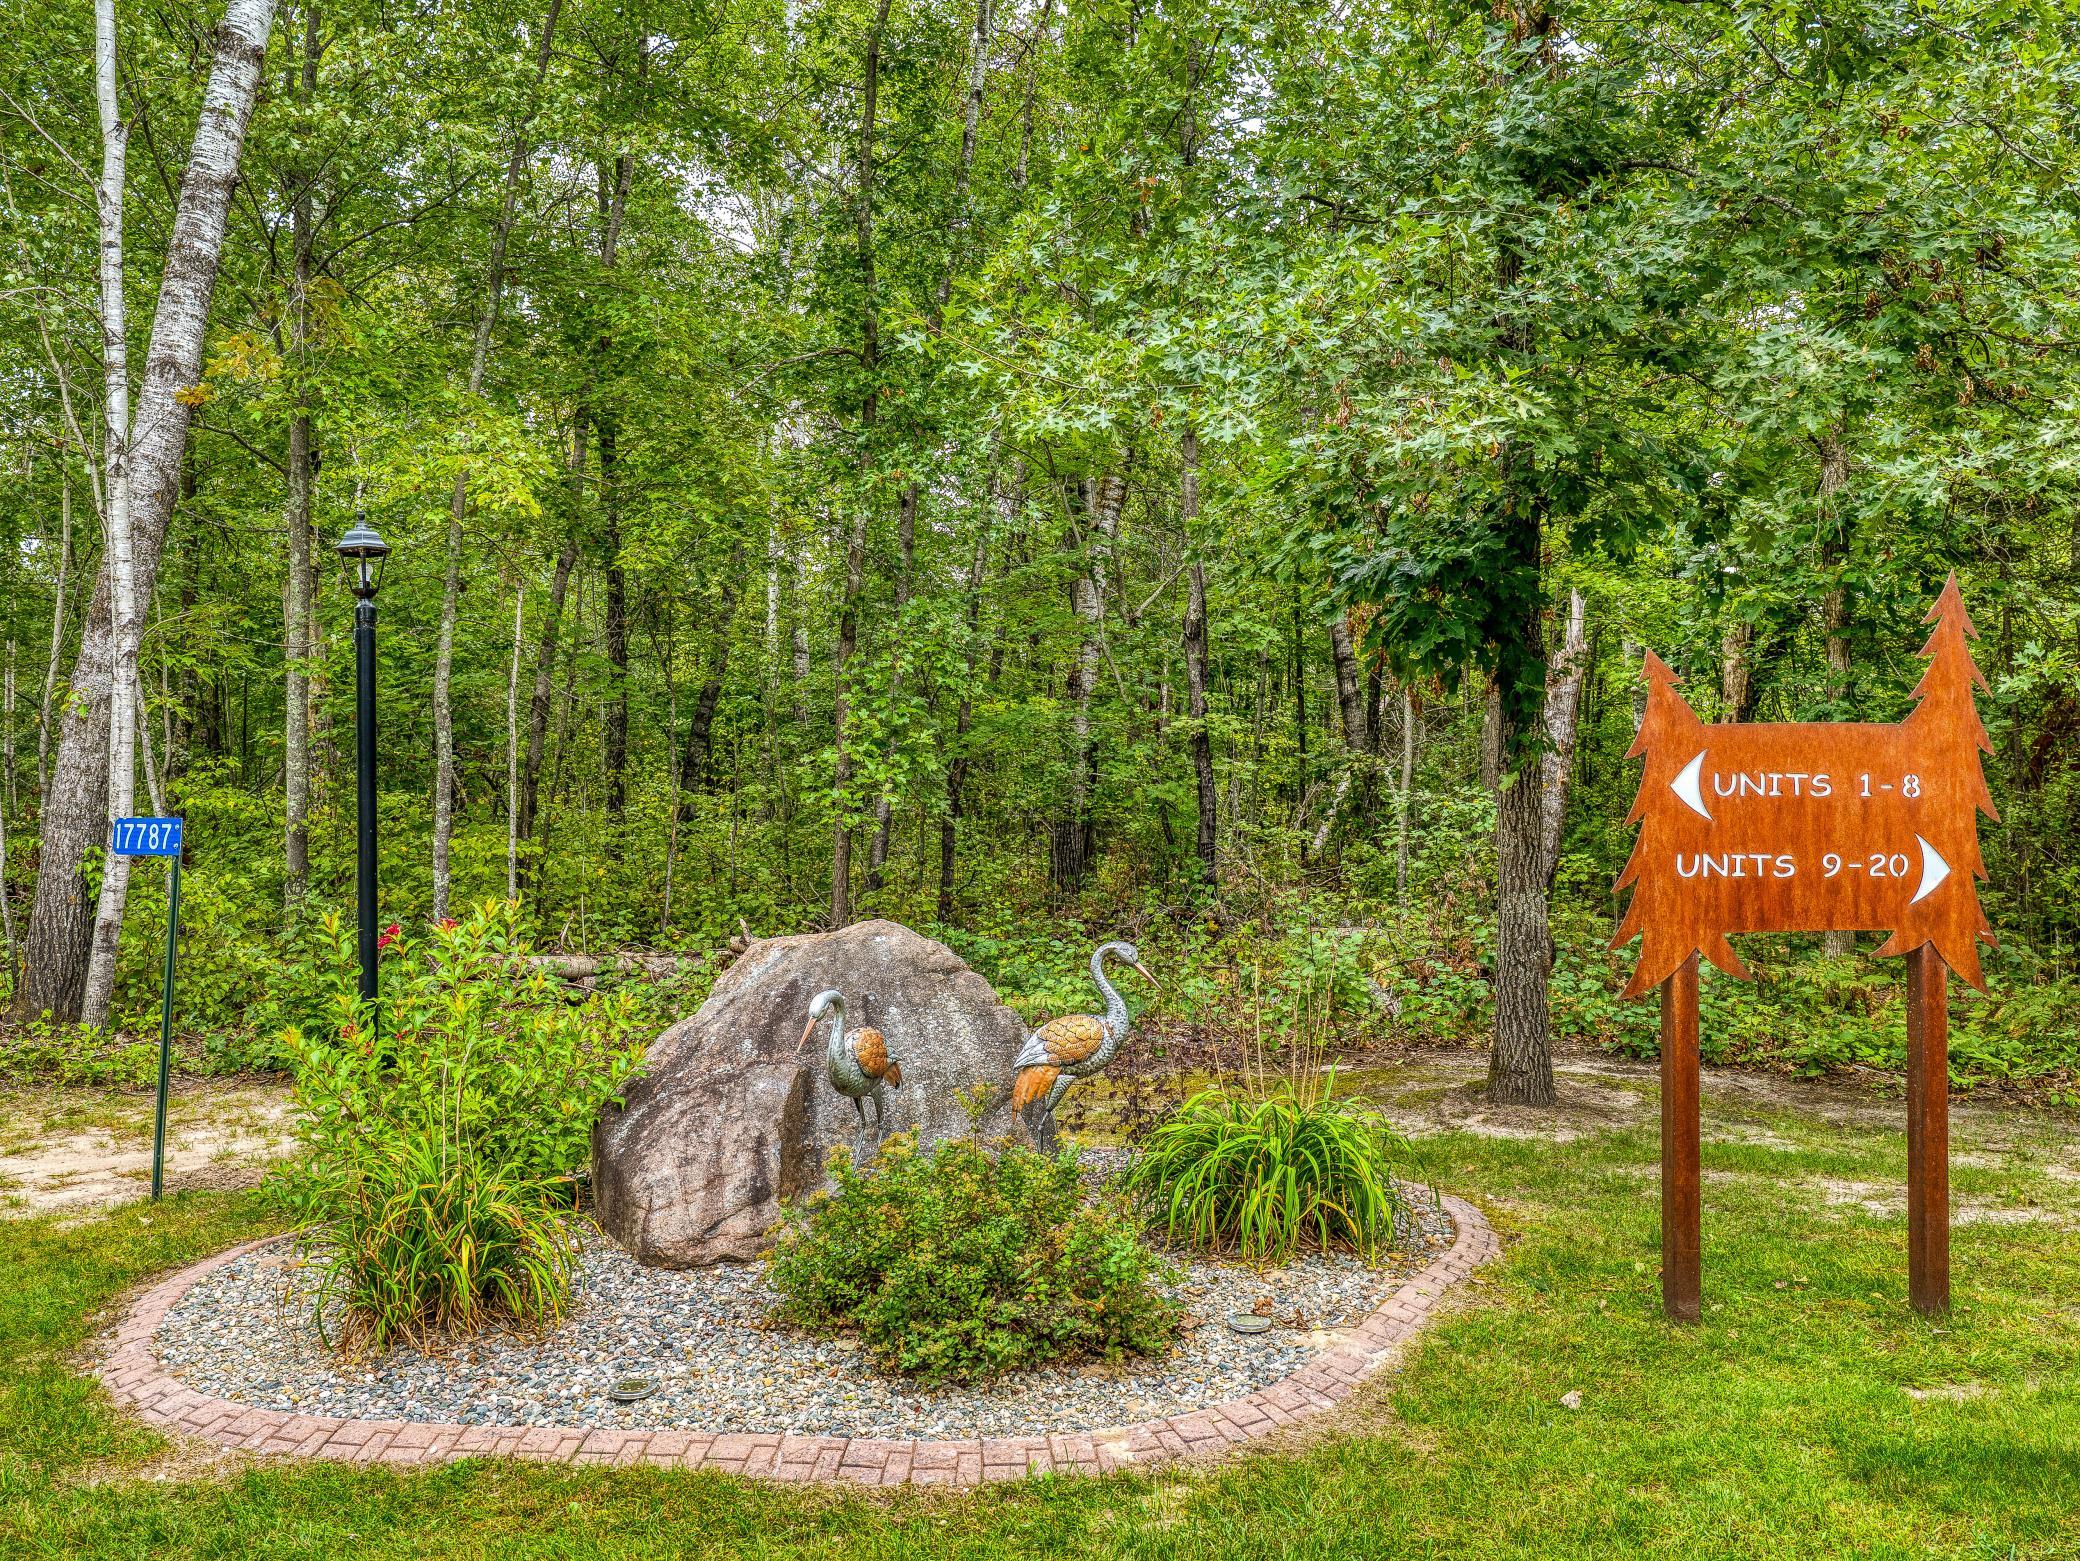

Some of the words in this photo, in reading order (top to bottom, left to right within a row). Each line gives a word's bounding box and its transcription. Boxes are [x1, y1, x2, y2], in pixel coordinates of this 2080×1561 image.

[1714, 772, 1832, 797] UNITS
[1860, 773, 1921, 798] 1-8
[116, 823, 172, 850] 17787
[1676, 853, 1795, 878] UNITS
[1822, 853, 1909, 878] 9-20
